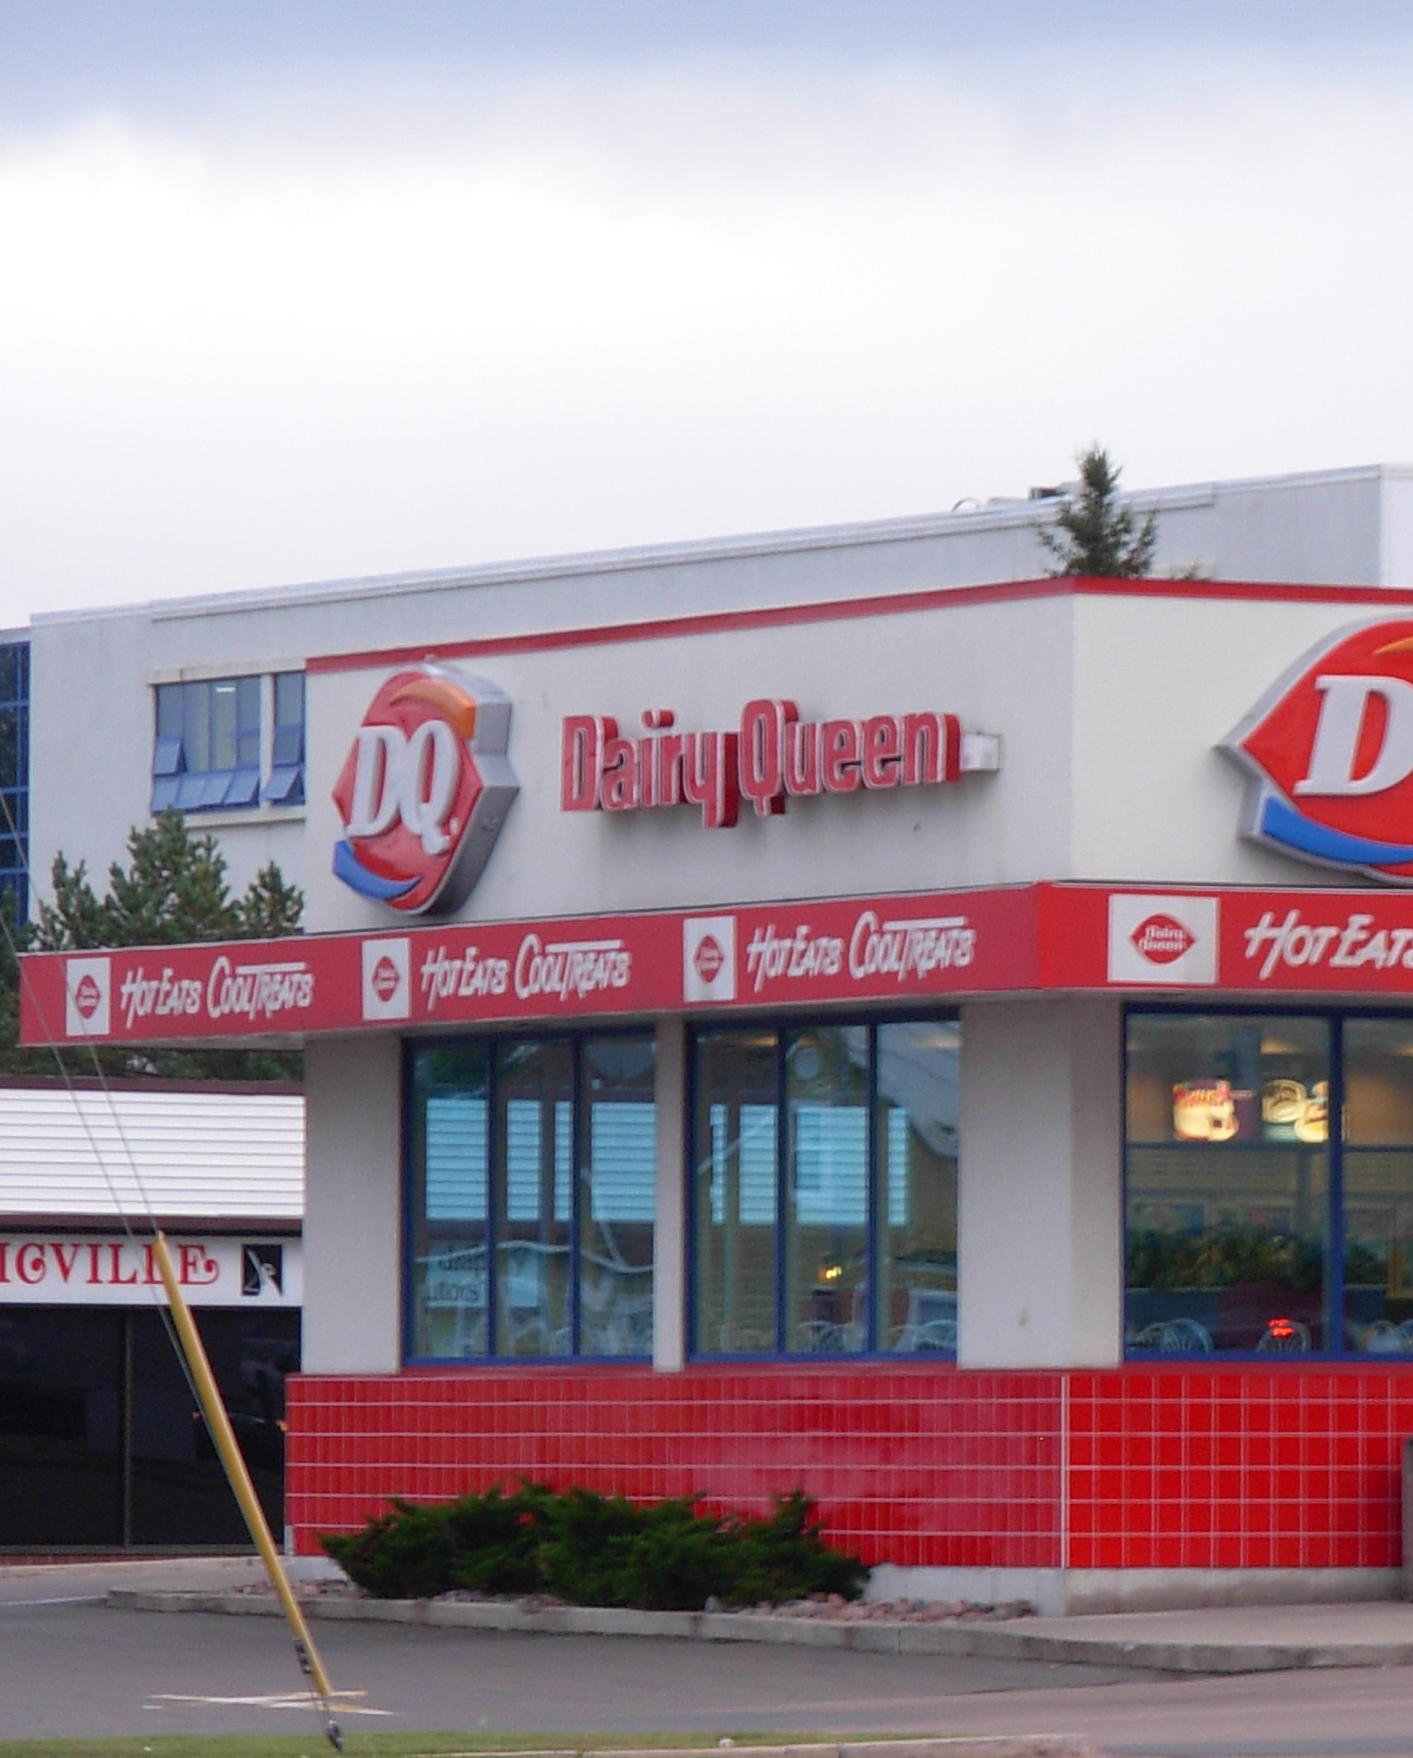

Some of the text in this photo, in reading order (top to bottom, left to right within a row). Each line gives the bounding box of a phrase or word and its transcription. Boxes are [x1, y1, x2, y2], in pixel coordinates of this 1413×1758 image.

[343, 719, 461, 855] DQ
[560, 698, 961, 828] Dairy Queen
